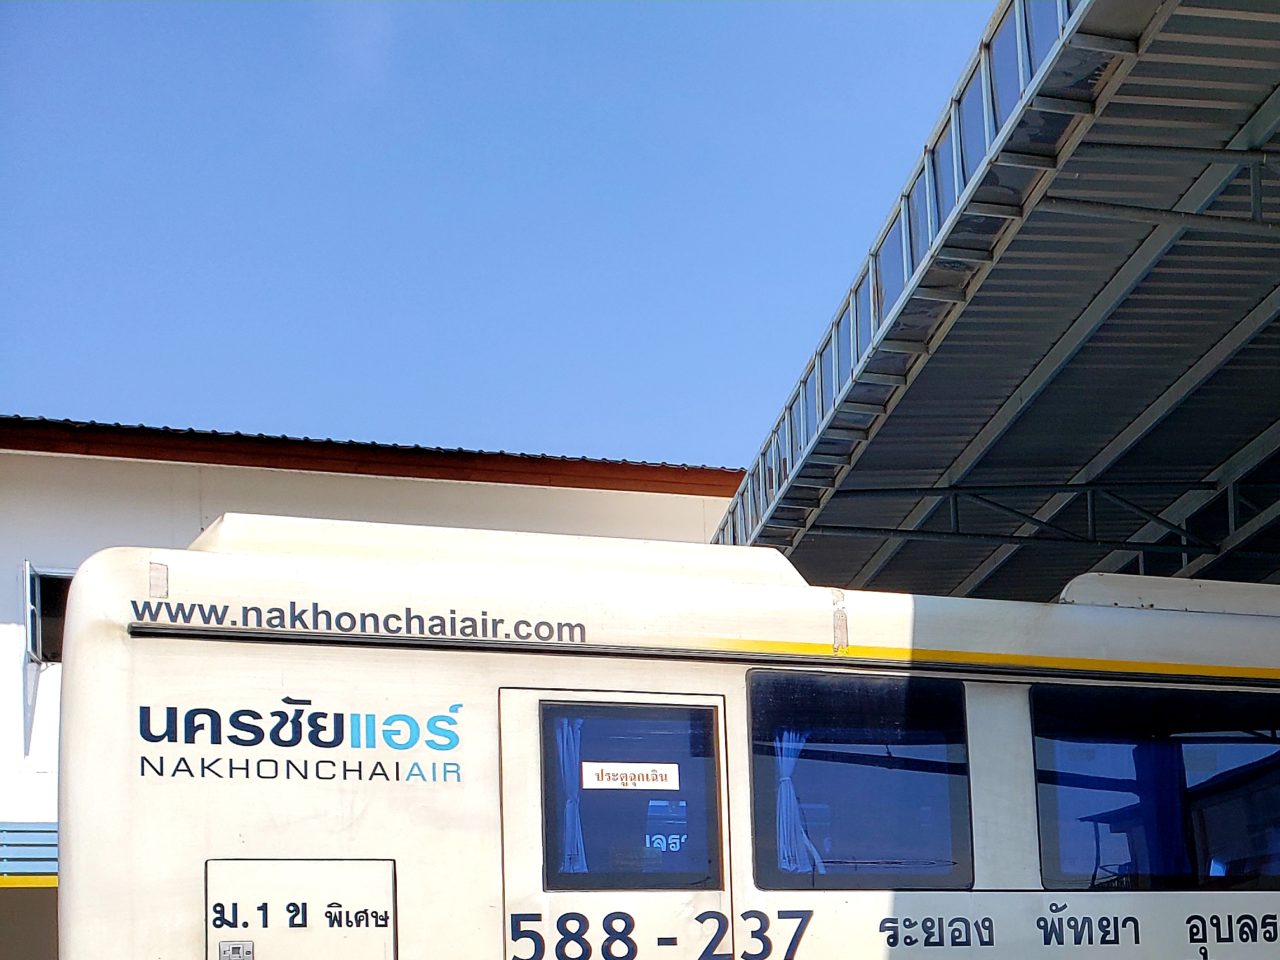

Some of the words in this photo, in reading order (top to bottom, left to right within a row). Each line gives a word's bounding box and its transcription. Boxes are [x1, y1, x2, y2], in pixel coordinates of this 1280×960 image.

[131, 600, 587, 642] www.nakhonchaiair.com
[139, 696, 464, 751] นครชัยแอร์
[140, 756, 462, 782] NAKHONCHAIAIR
[595, 768, 668, 787] ประตูฉุกเฉิน
[285, 902, 308, 929] ข
[325, 902, 390, 929] พิเศษ
[879, 917, 995, 947] ระยอง
[1036, 902, 1141, 946] พัทยา
